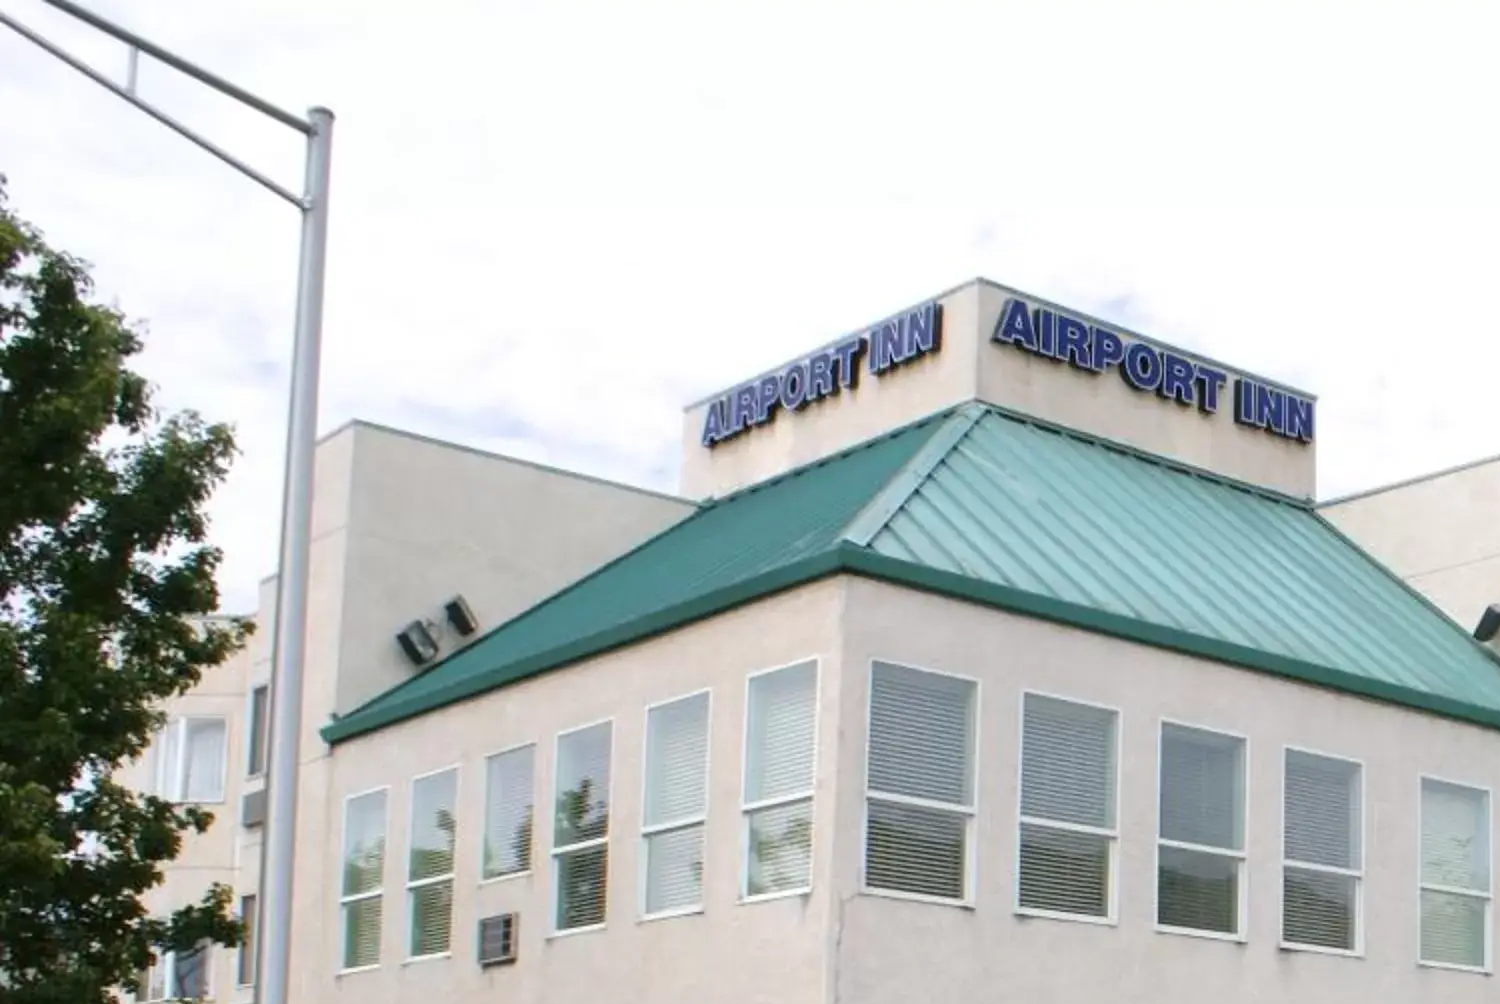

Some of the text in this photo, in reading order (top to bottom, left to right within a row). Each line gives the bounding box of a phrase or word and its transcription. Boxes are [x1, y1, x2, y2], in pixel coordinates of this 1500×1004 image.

[701, 301, 942, 447] AIRPORT INN
[992, 298, 1313, 444] AIRPORT INN
